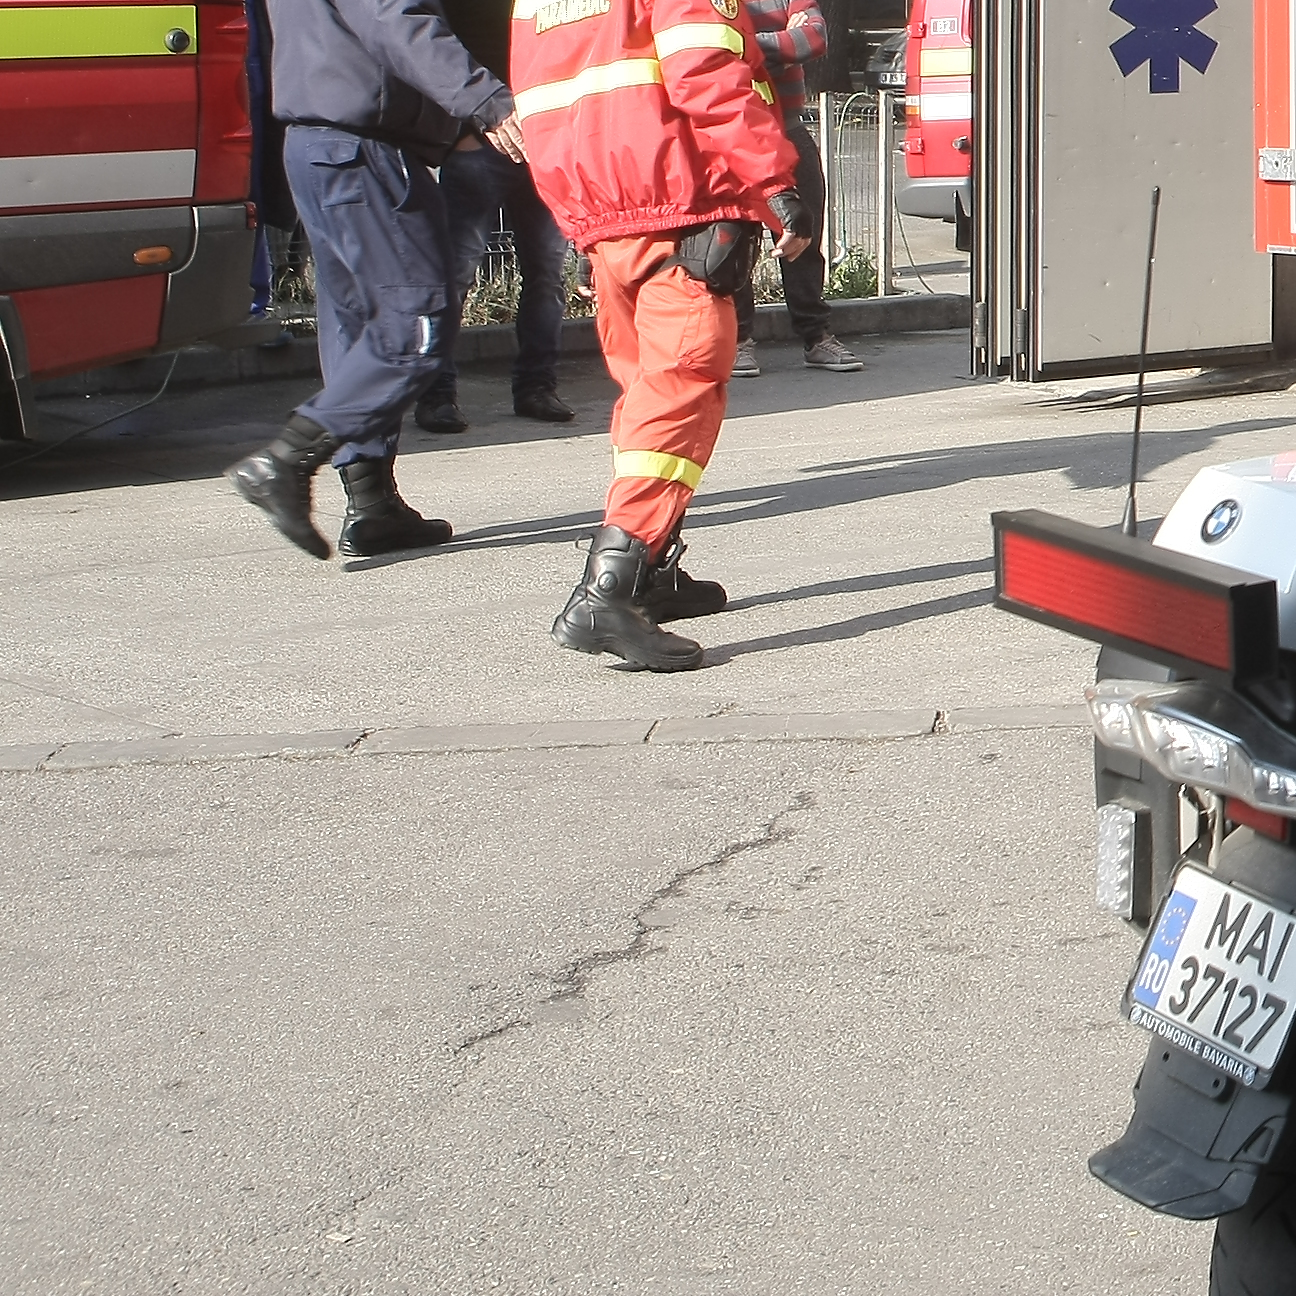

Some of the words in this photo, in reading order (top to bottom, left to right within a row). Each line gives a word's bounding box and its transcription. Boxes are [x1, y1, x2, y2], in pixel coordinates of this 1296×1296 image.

[1204, 891, 1296, 983] MAI
[1139, 952, 1171, 994] RO
[1169, 955, 1288, 1054] 37127
[1140, 1010, 1202, 1054] AUTOMOBILE
[1202, 1044, 1245, 1079] BAVARIA
